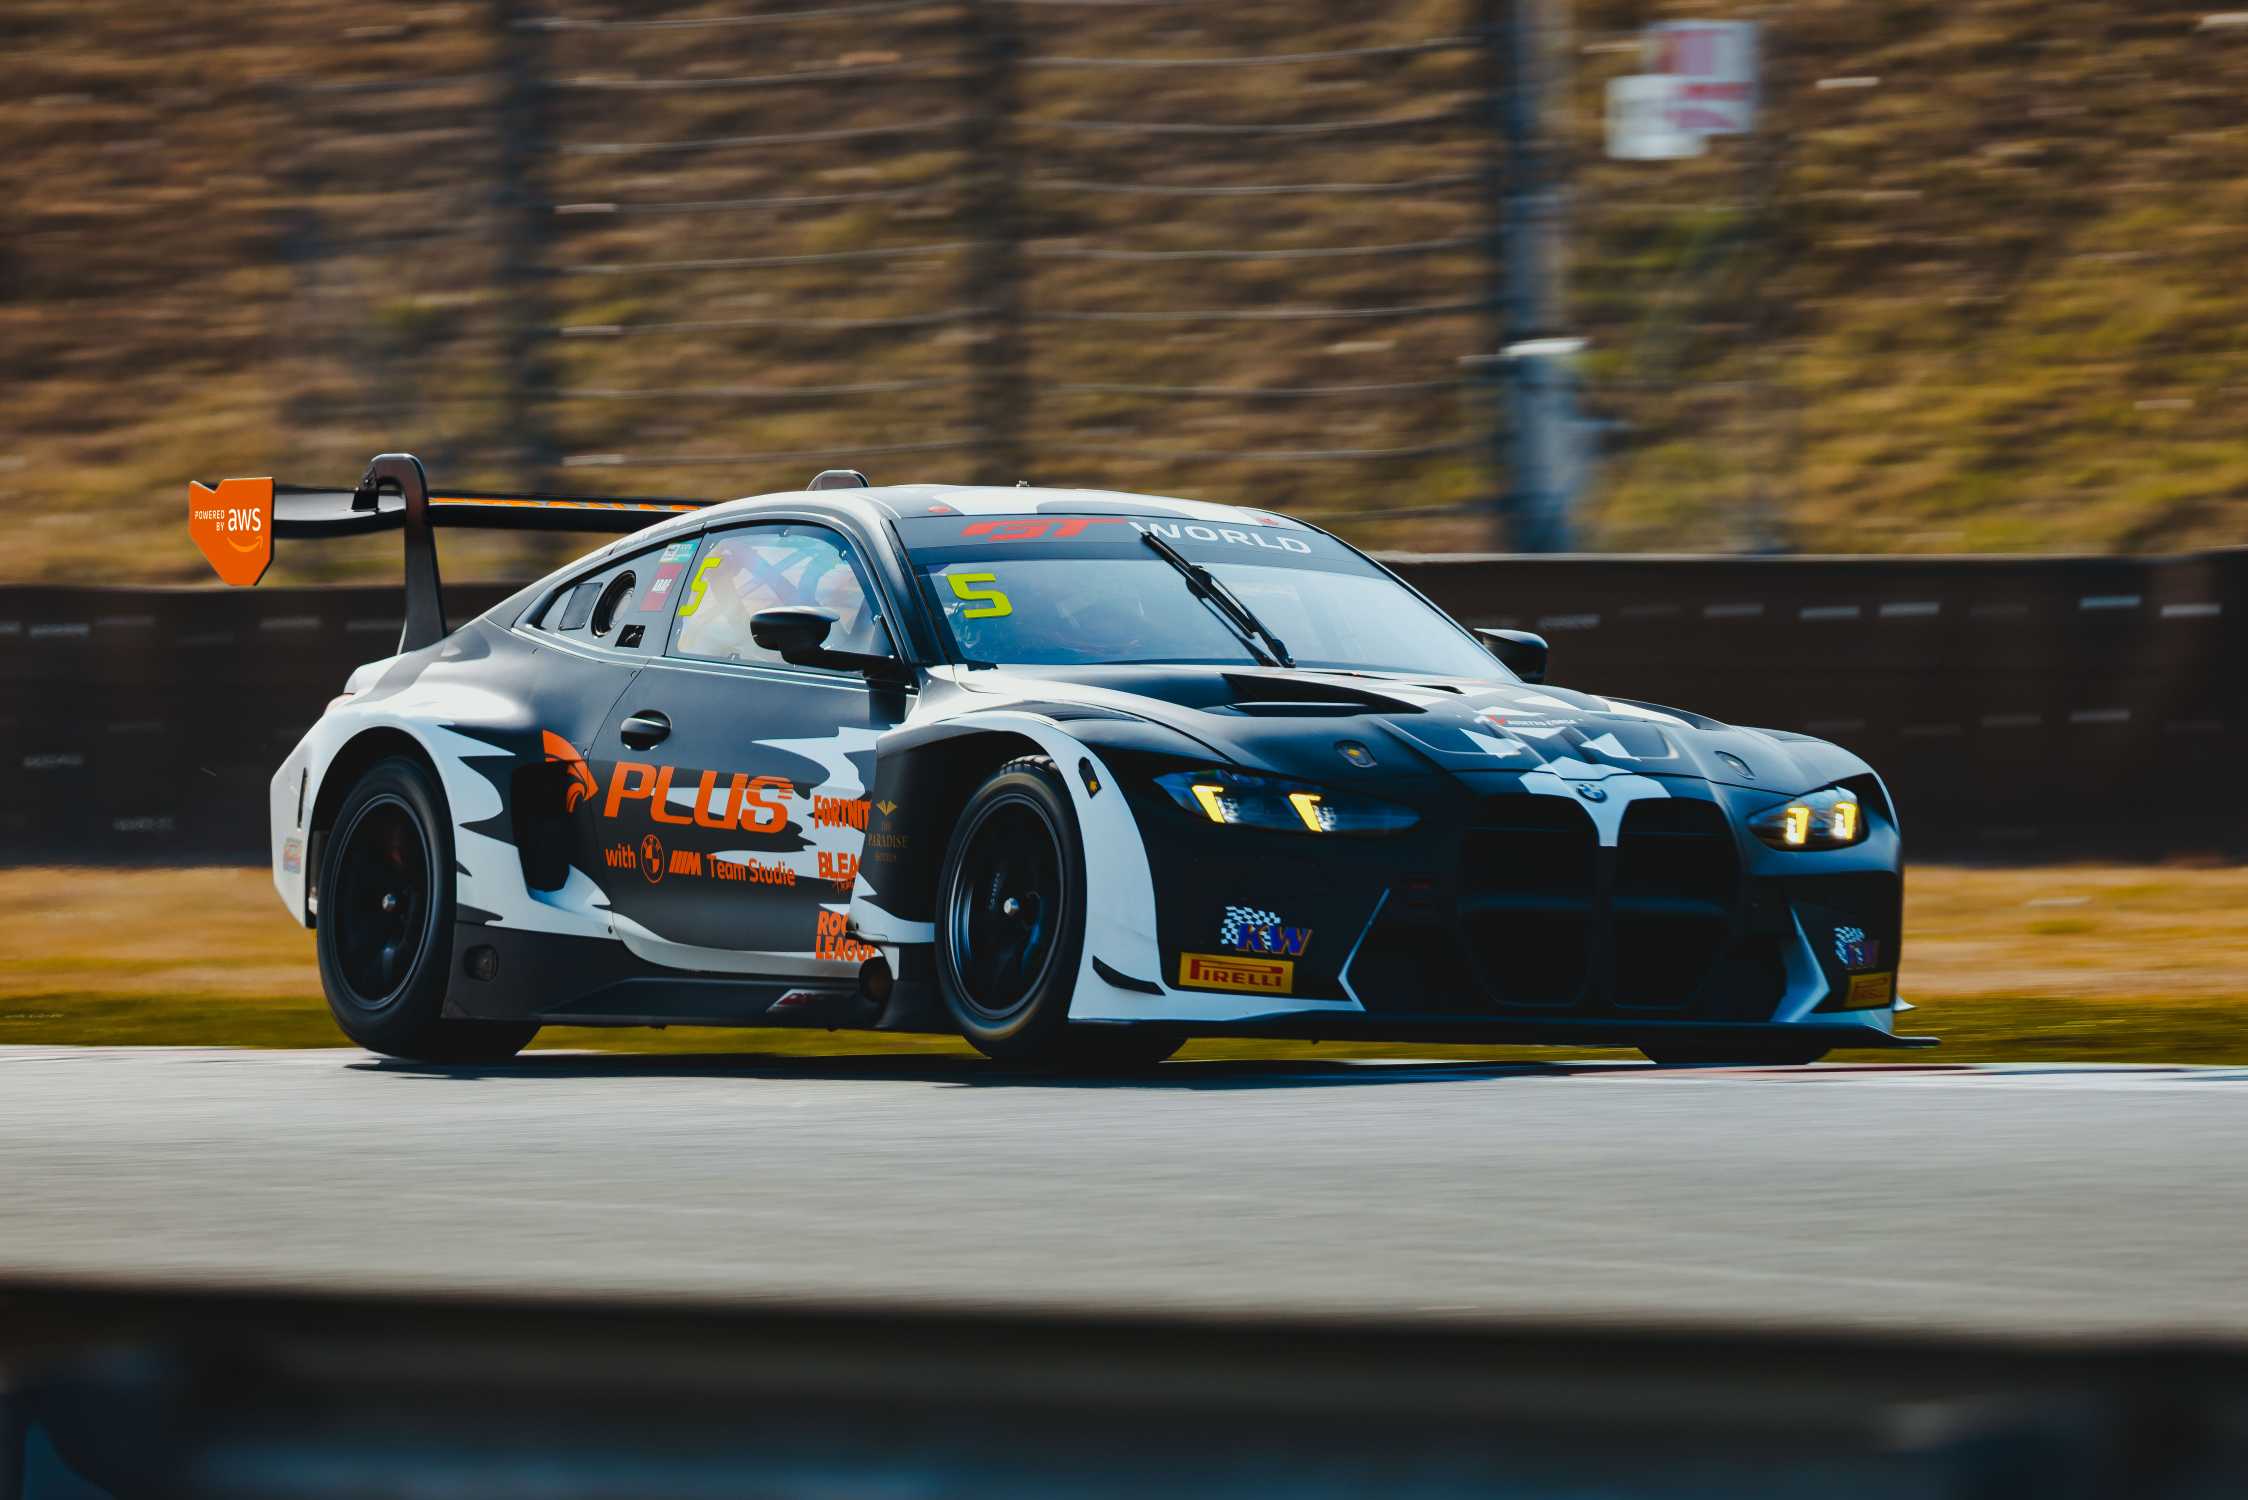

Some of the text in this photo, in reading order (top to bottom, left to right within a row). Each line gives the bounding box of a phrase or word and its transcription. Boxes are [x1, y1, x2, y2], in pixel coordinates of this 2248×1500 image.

[194, 509, 225, 520] POWERED
[215, 521, 225, 532] BY
[227, 507, 262, 532] aws
[1128, 520, 1312, 555] WORLD
[678, 556, 722, 617] 5
[946, 572, 1013, 619] 5
[603, 761, 794, 834] PLUS
[604, 843, 636, 869] with
[706, 853, 747, 881] Team
[749, 857, 798, 887] Studie
[817, 851, 862, 881] BLEA
[1236, 923, 1313, 956] KW
[1189, 958, 1285, 987] PIRELLI
